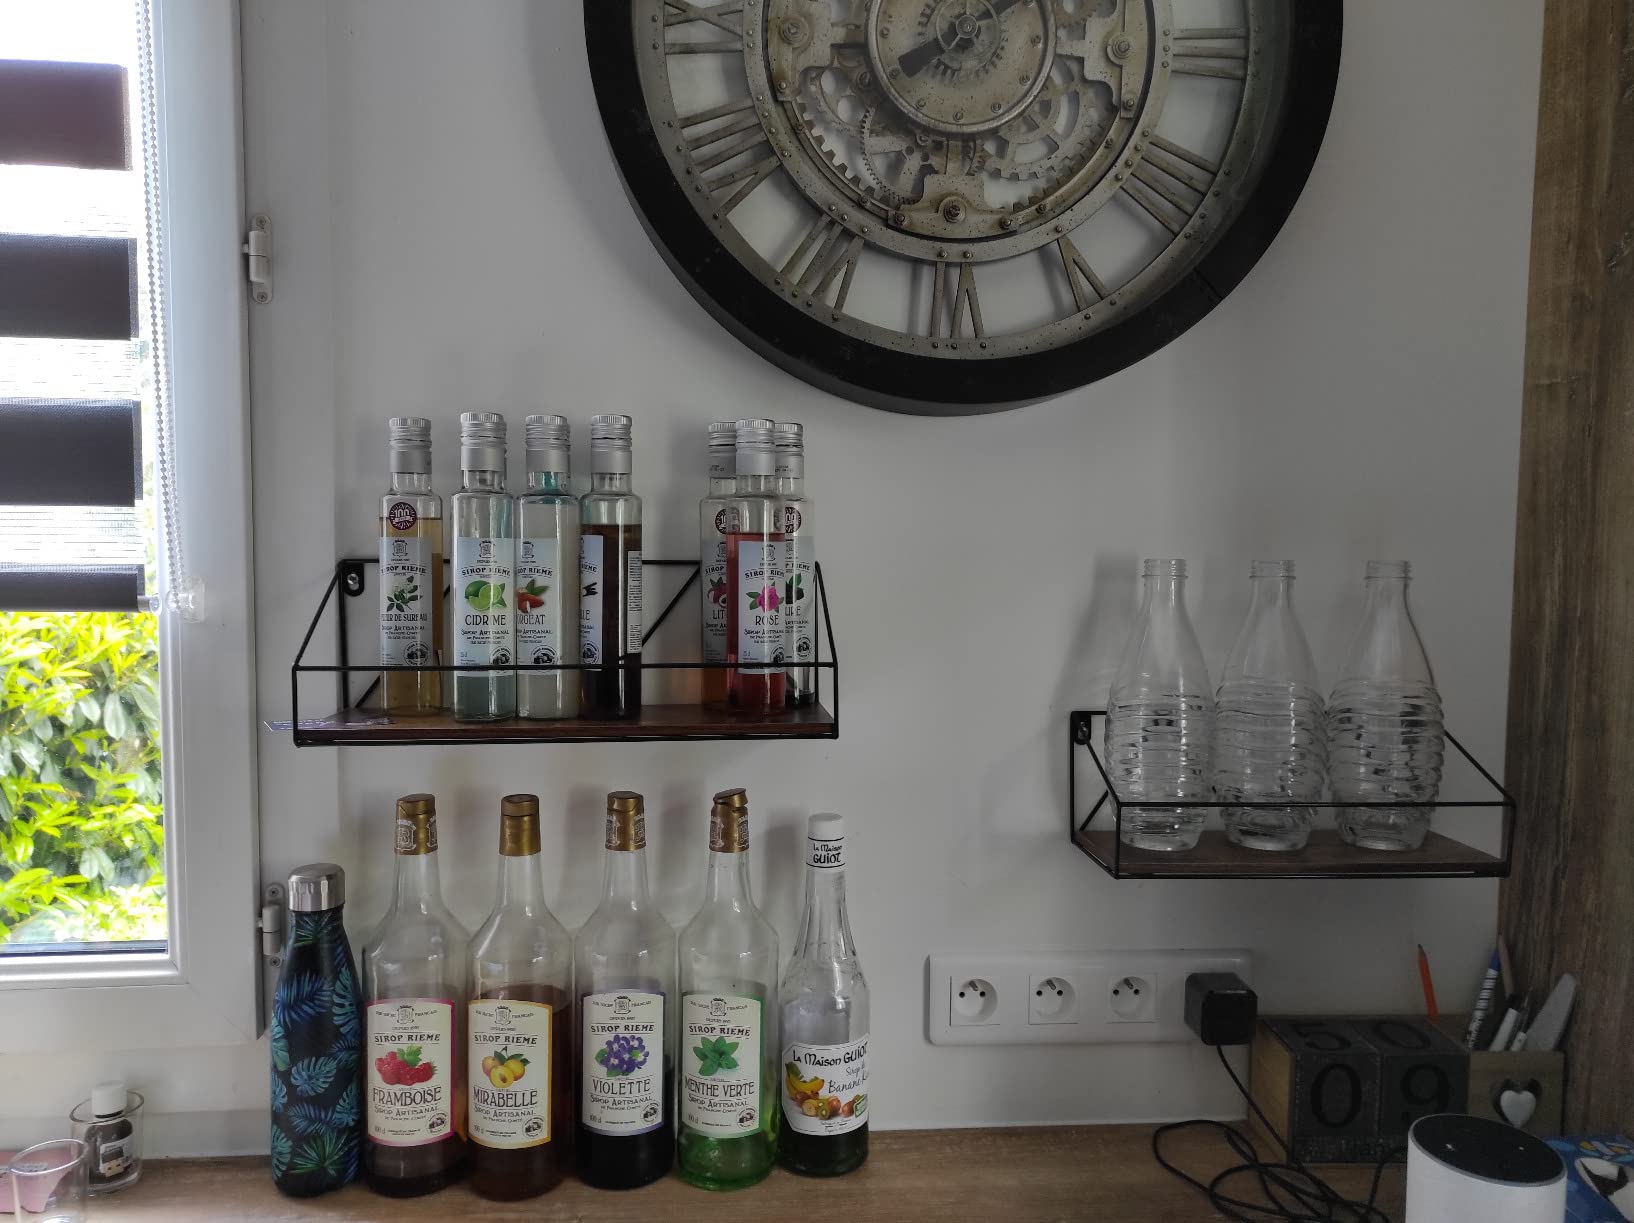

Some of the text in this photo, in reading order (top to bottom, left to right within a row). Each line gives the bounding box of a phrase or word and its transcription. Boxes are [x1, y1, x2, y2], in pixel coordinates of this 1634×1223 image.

[462, 567, 486, 576] SIROP
[744, 570, 766, 579] SIRO
[464, 614, 507, 626] CIDRME
[518, 614, 546, 625] RGEAT
[590, 1024, 655, 1033] SIROP RIEME
[689, 1025, 751, 1037] SIROP RIEME
[374, 1033, 441, 1043] SIROP RIEME
[474, 1034, 538, 1045] SIROP RIEME
[804, 1052, 842, 1067] Maison
[592, 1078, 651, 1095] VIOLETTE
[684, 1076, 755, 1098] MENTHE VERTE
[373, 1085, 442, 1107] FRAMBOISE
[473, 1086, 538, 1108] MIRABELLE
